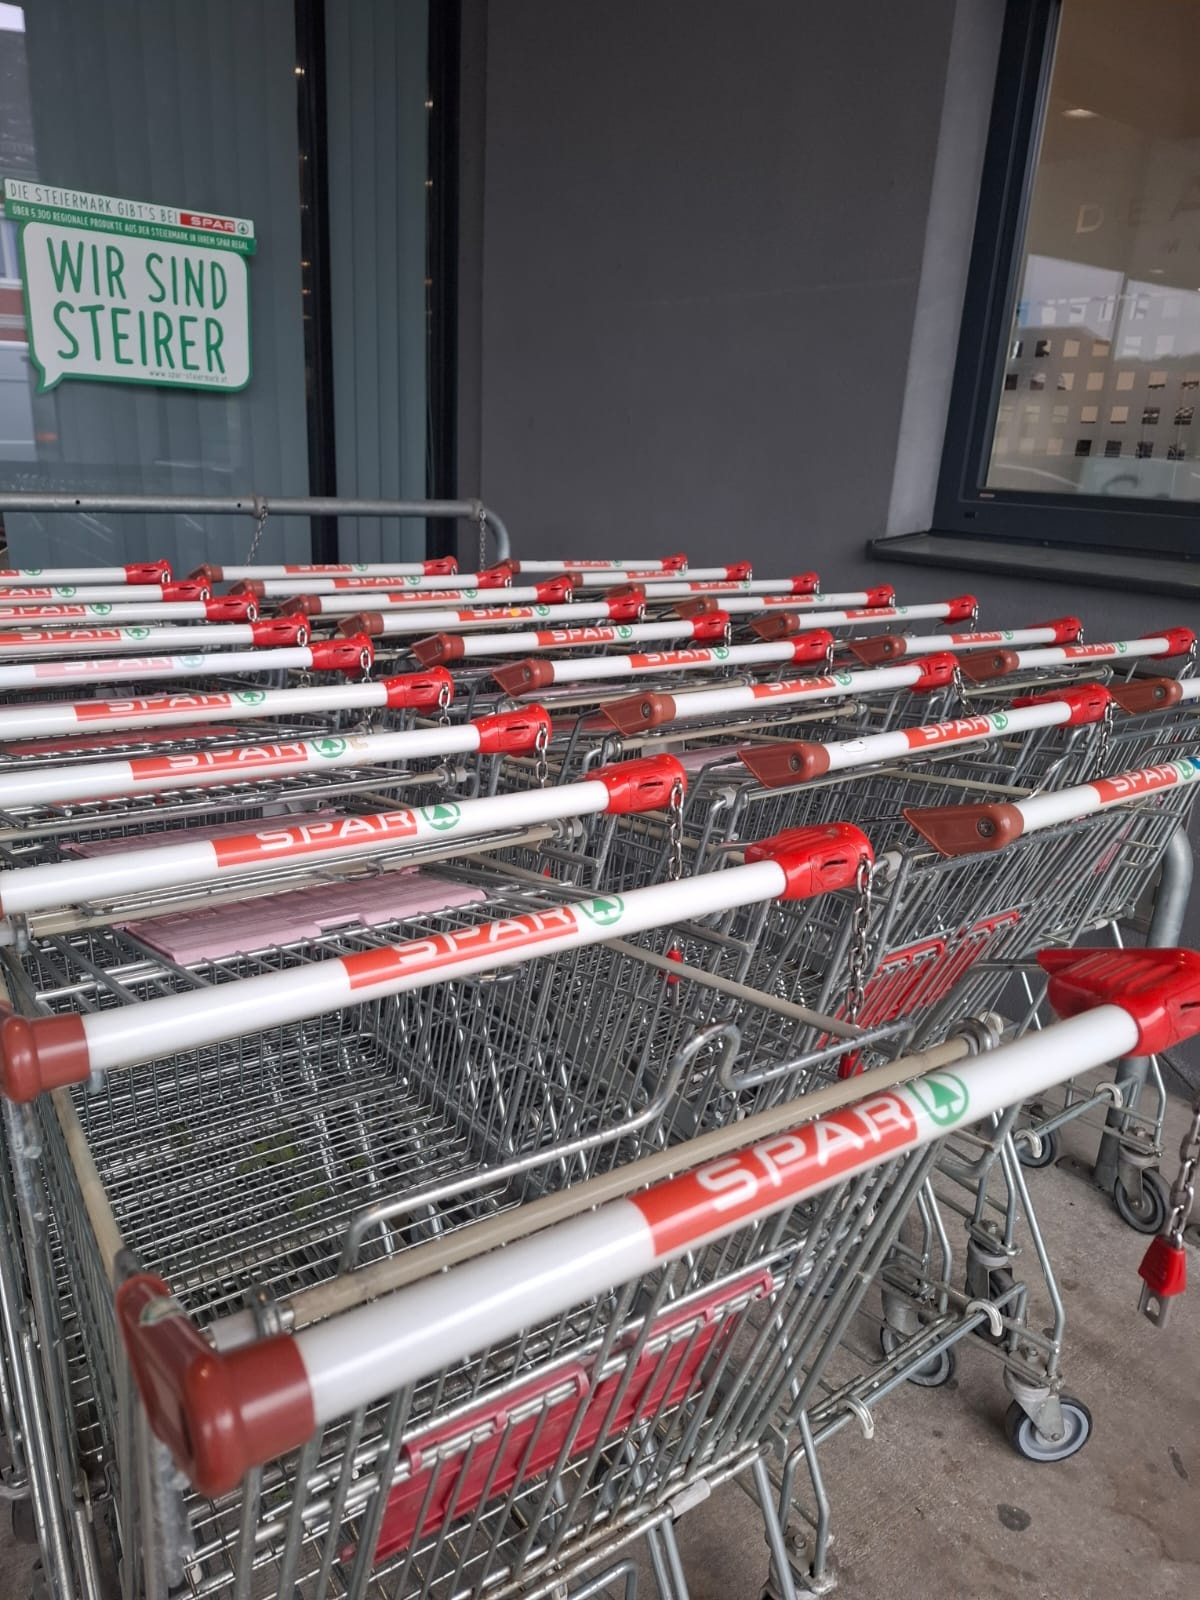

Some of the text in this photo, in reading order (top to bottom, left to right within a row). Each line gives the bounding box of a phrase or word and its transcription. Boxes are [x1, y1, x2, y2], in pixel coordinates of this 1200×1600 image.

[10, 182, 236, 232] DIE STEIERMARK GIBT'S BEI SPAR
[53, 211, 88, 227] REGIONALE
[46, 236, 227, 311] WIR SIND
[53, 300, 226, 374] STEIRER
[552, 626, 613, 641] SPAR
[919, 715, 988, 740] SPAR
[1108, 763, 1177, 793] SPAR
[256, 809, 413, 851] SPAR
[696, 1095, 913, 1212] SPAR
